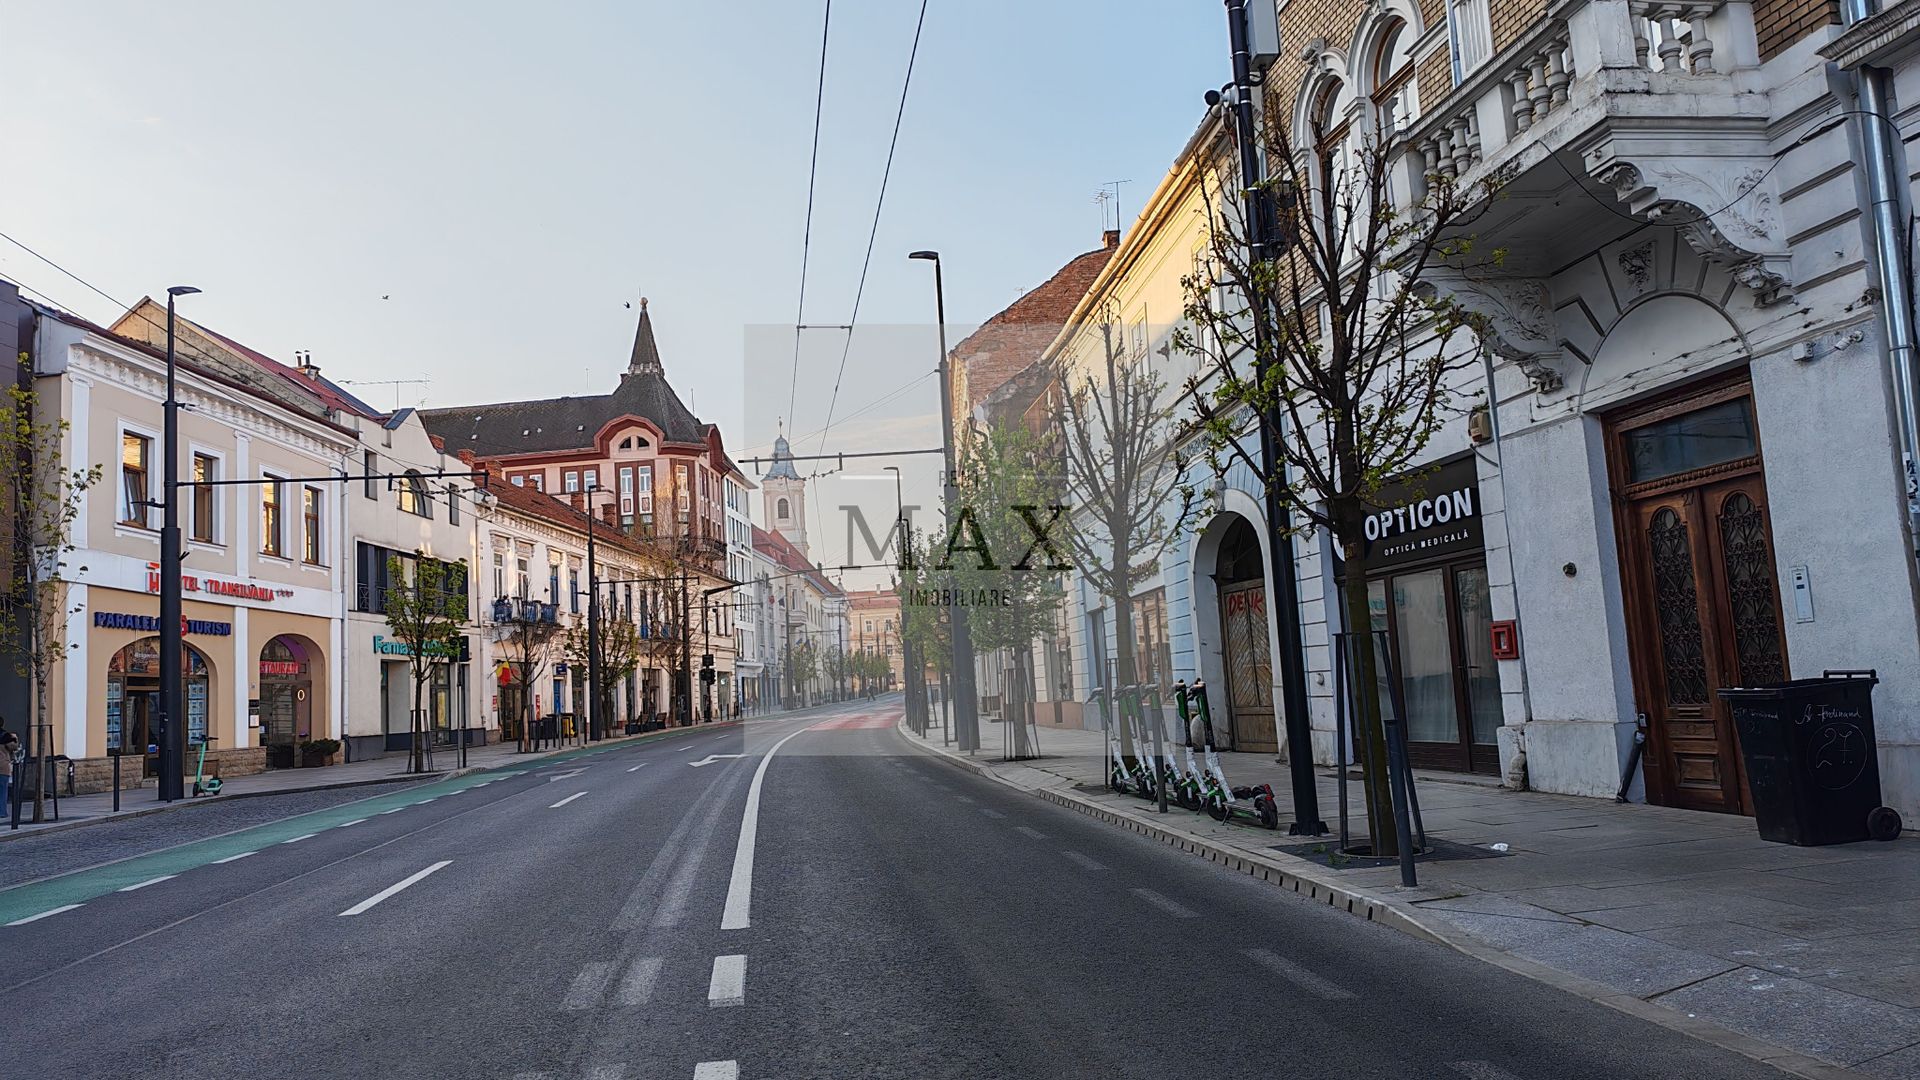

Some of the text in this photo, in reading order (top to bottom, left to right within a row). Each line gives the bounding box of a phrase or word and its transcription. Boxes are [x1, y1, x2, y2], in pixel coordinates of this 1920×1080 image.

[1364, 487, 1473, 541] OPTICON
[145, 567, 275, 601] HTEL TRANSILVANIA
